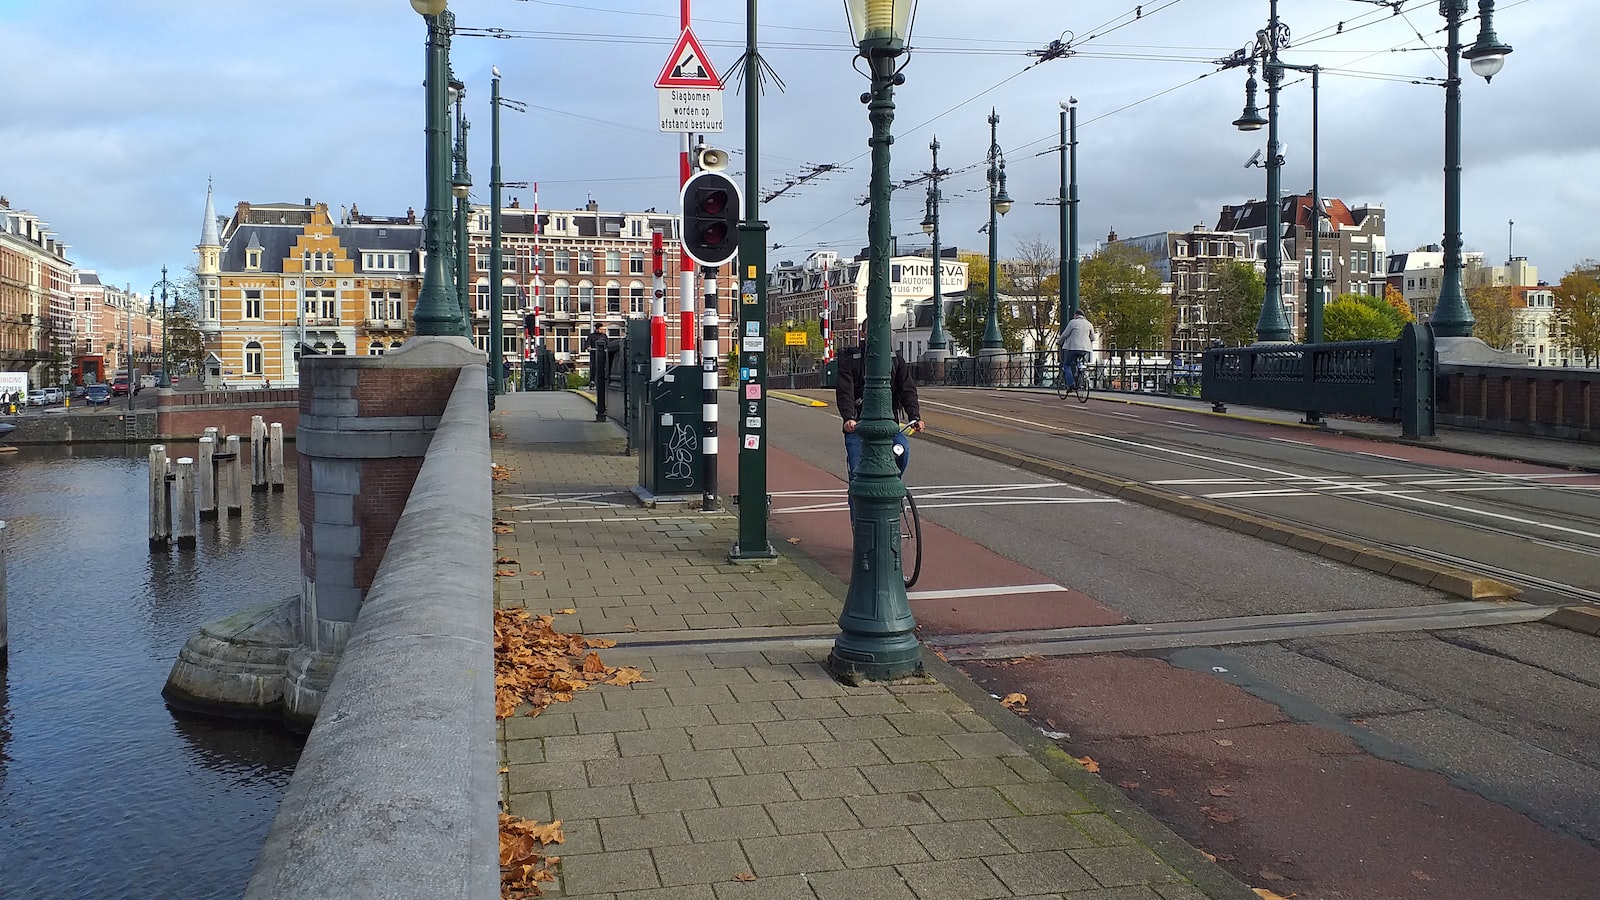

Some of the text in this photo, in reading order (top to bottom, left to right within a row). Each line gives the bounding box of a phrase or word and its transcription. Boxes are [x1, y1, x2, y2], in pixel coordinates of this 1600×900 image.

[671, 90, 711, 103] Slagbomen
[673, 105, 709, 117] worden op
[661, 118, 722, 129] afstand bestuurd
[902, 265, 963, 276] MINERVA
[902, 277, 963, 286] AUTOMOELEN
[912, 286, 924, 294] MY
